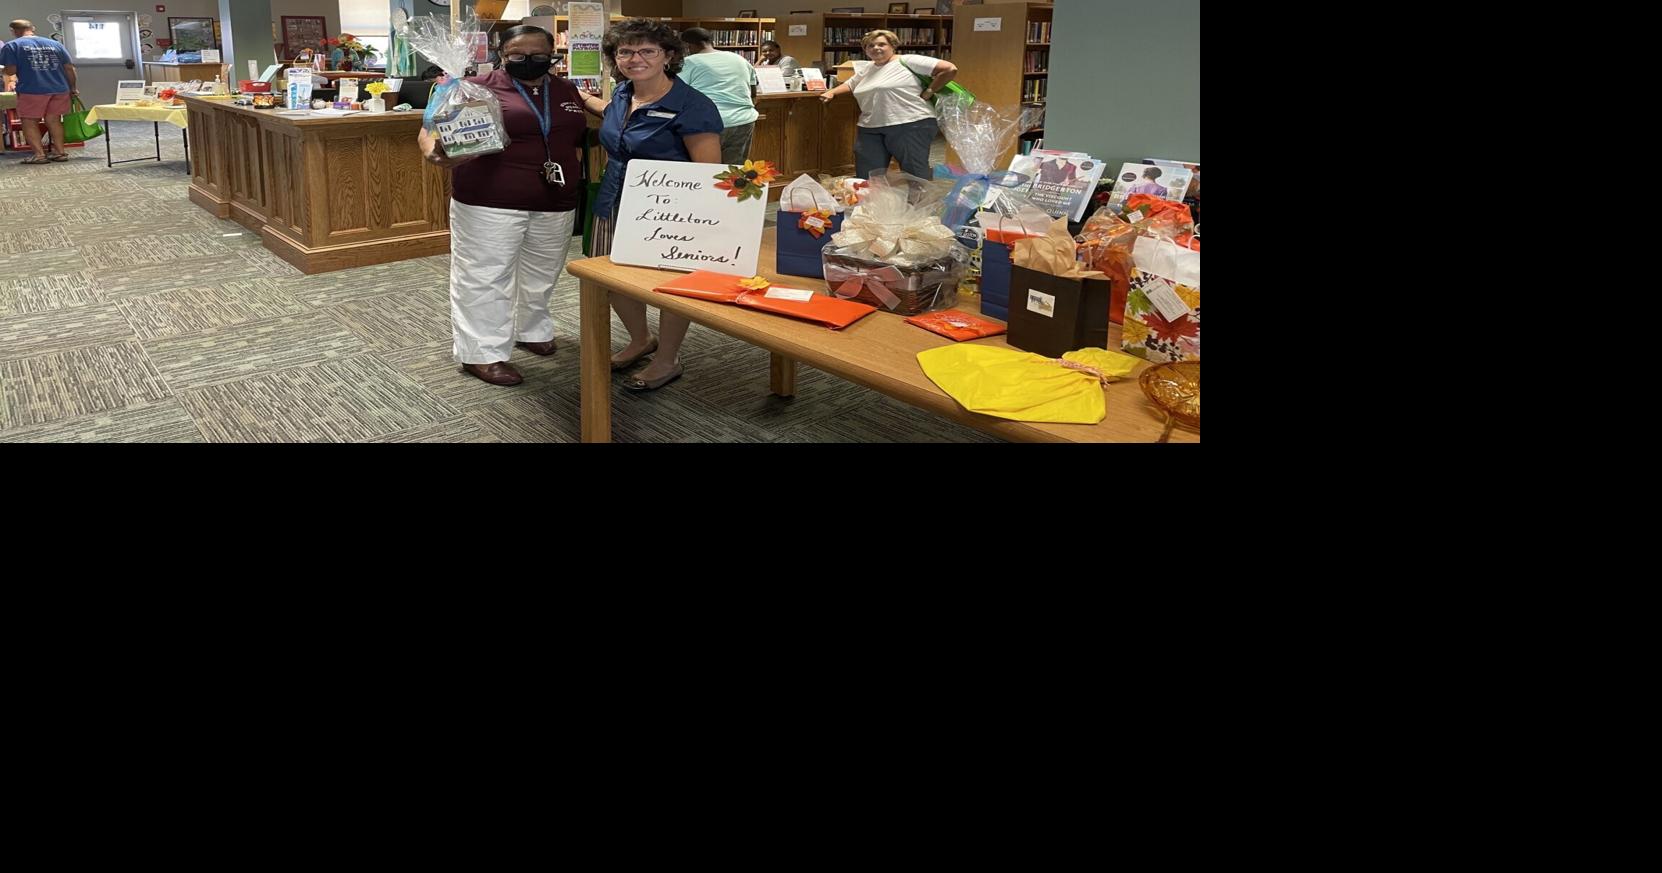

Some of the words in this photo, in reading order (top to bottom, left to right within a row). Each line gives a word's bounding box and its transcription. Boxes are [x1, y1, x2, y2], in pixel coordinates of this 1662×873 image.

[629, 169, 703, 190] Welcome
[1032, 183, 1082, 194] BRIDGERTON
[636, 209, 720, 226] Littleton
[644, 227, 695, 242] Loves
[661, 246, 742, 267] Seniors!
